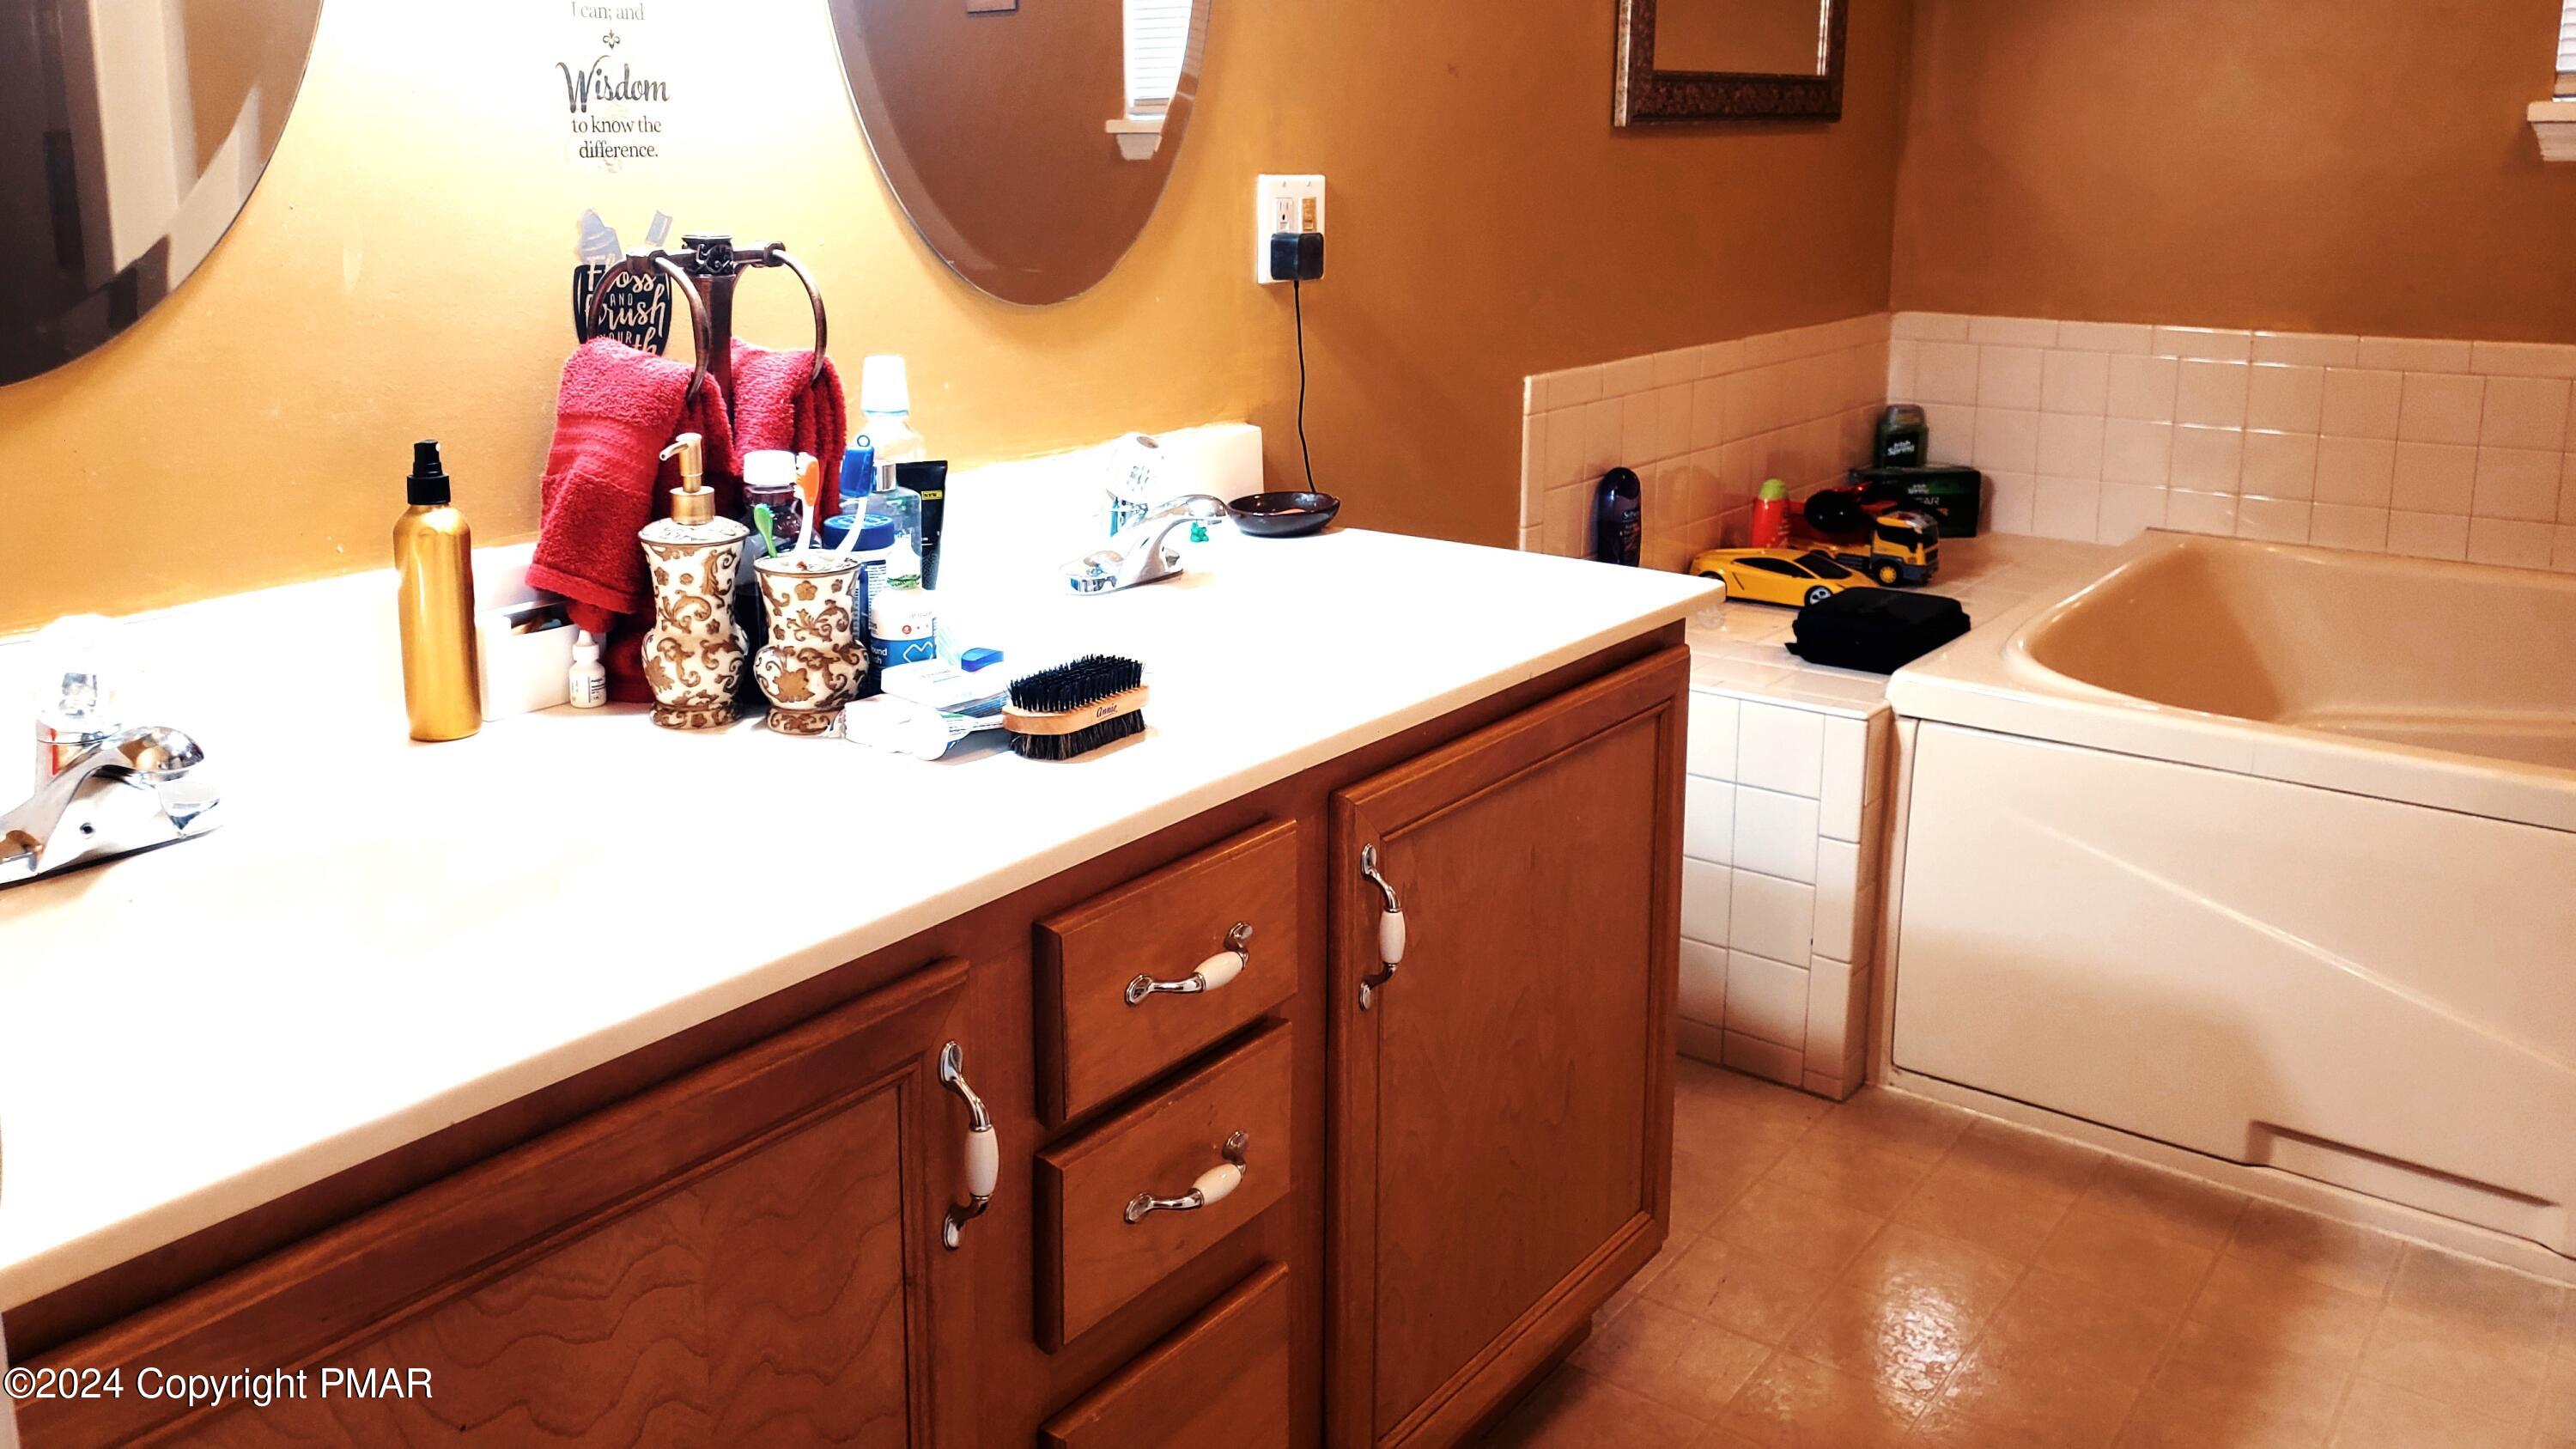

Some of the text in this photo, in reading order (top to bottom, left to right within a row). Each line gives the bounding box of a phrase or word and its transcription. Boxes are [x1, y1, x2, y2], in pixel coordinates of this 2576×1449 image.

[571, 1, 646, 21] I can; and
[556, 55, 670, 113] Wisdom
[572, 115, 662, 133] to know the
[579, 140, 659, 159] difference.
[611, 293, 633, 307] AND
[600, 332, 633, 344] OUR
